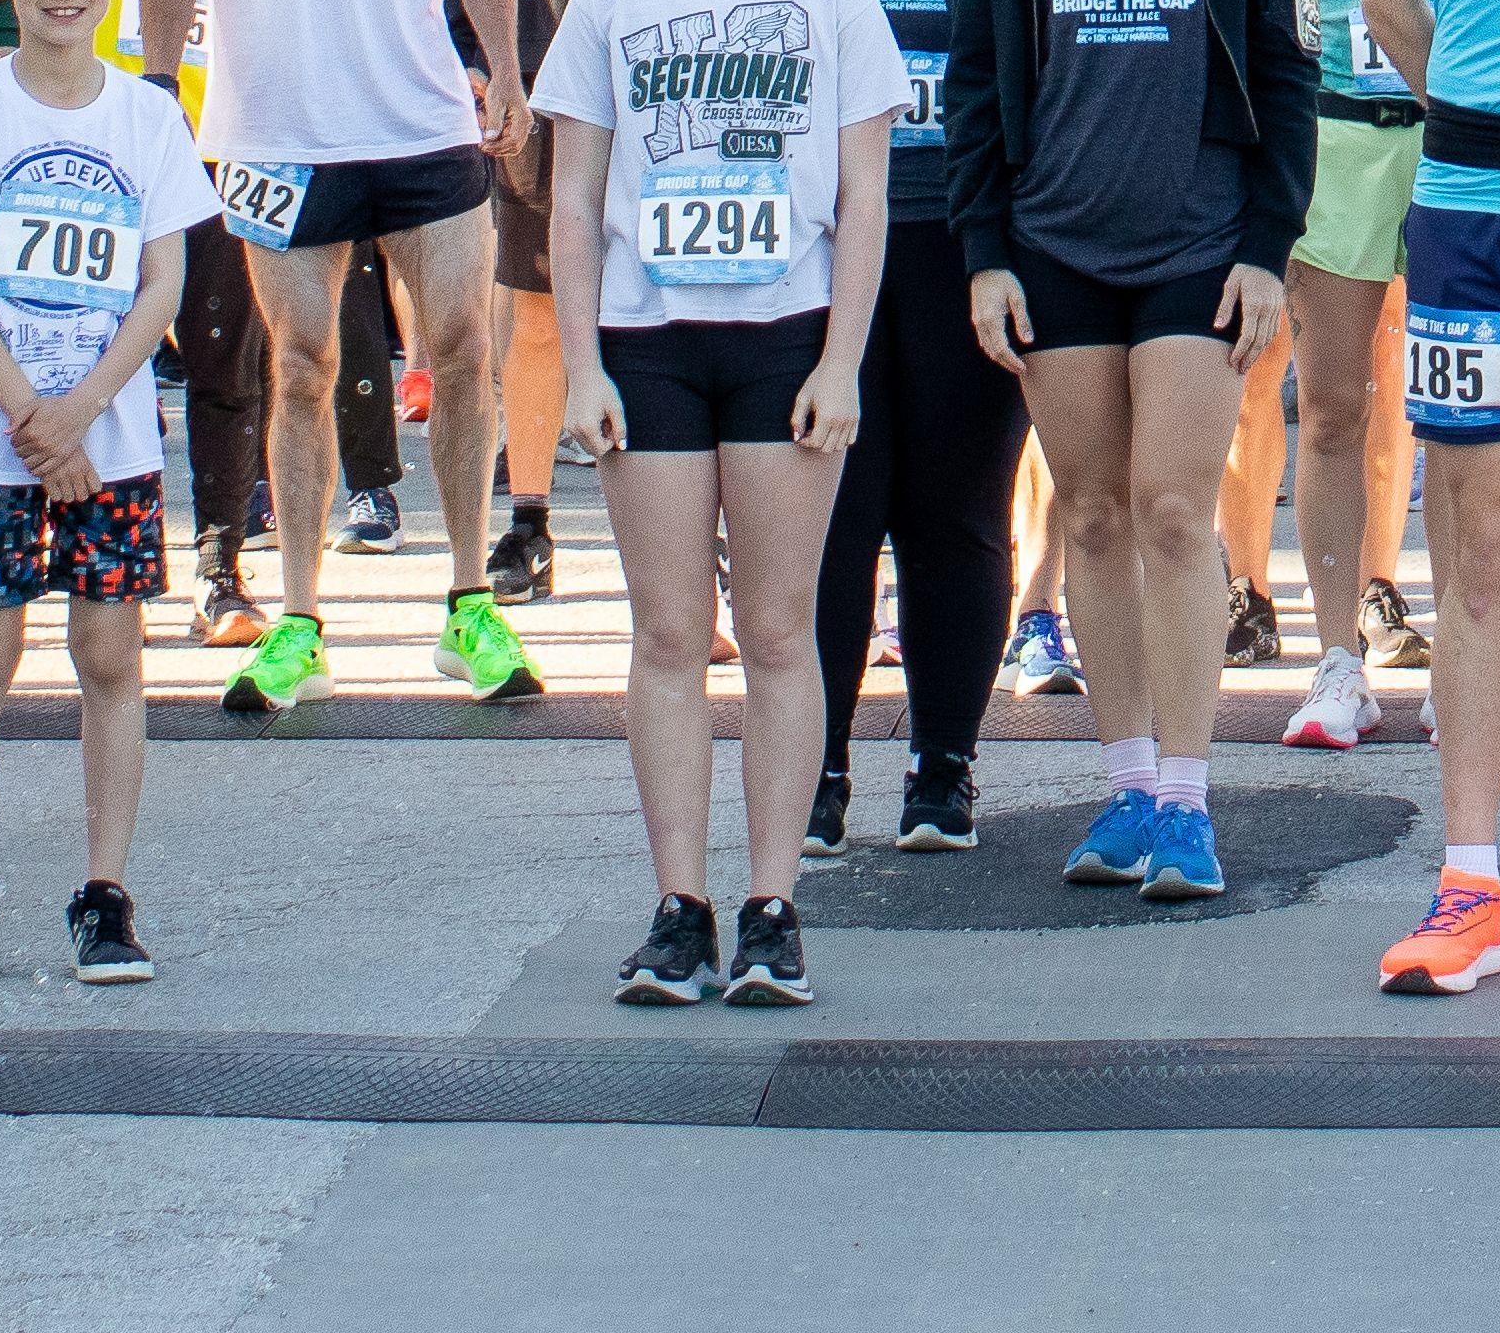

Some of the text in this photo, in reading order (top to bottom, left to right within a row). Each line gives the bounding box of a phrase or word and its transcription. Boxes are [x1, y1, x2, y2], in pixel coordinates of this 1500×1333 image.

[1085, 11, 1161, 23] TO HEALTH RACE
[630, 52, 813, 111] SECTIONAL
[702, 108, 805, 125] CROSS COUNTRY
[740, 134, 777, 154] IESA
[656, 174, 749, 190] BRIDGE THE GAP
[59, 197, 80, 212] THE
[221, 161, 296, 230] 1242
[653, 200, 780, 256] 1294
[16, 218, 117, 282] 709
[1429, 319, 1447, 334] THE
[1447, 322, 1470, 336] GAP
[1409, 341, 1483, 403] 185
